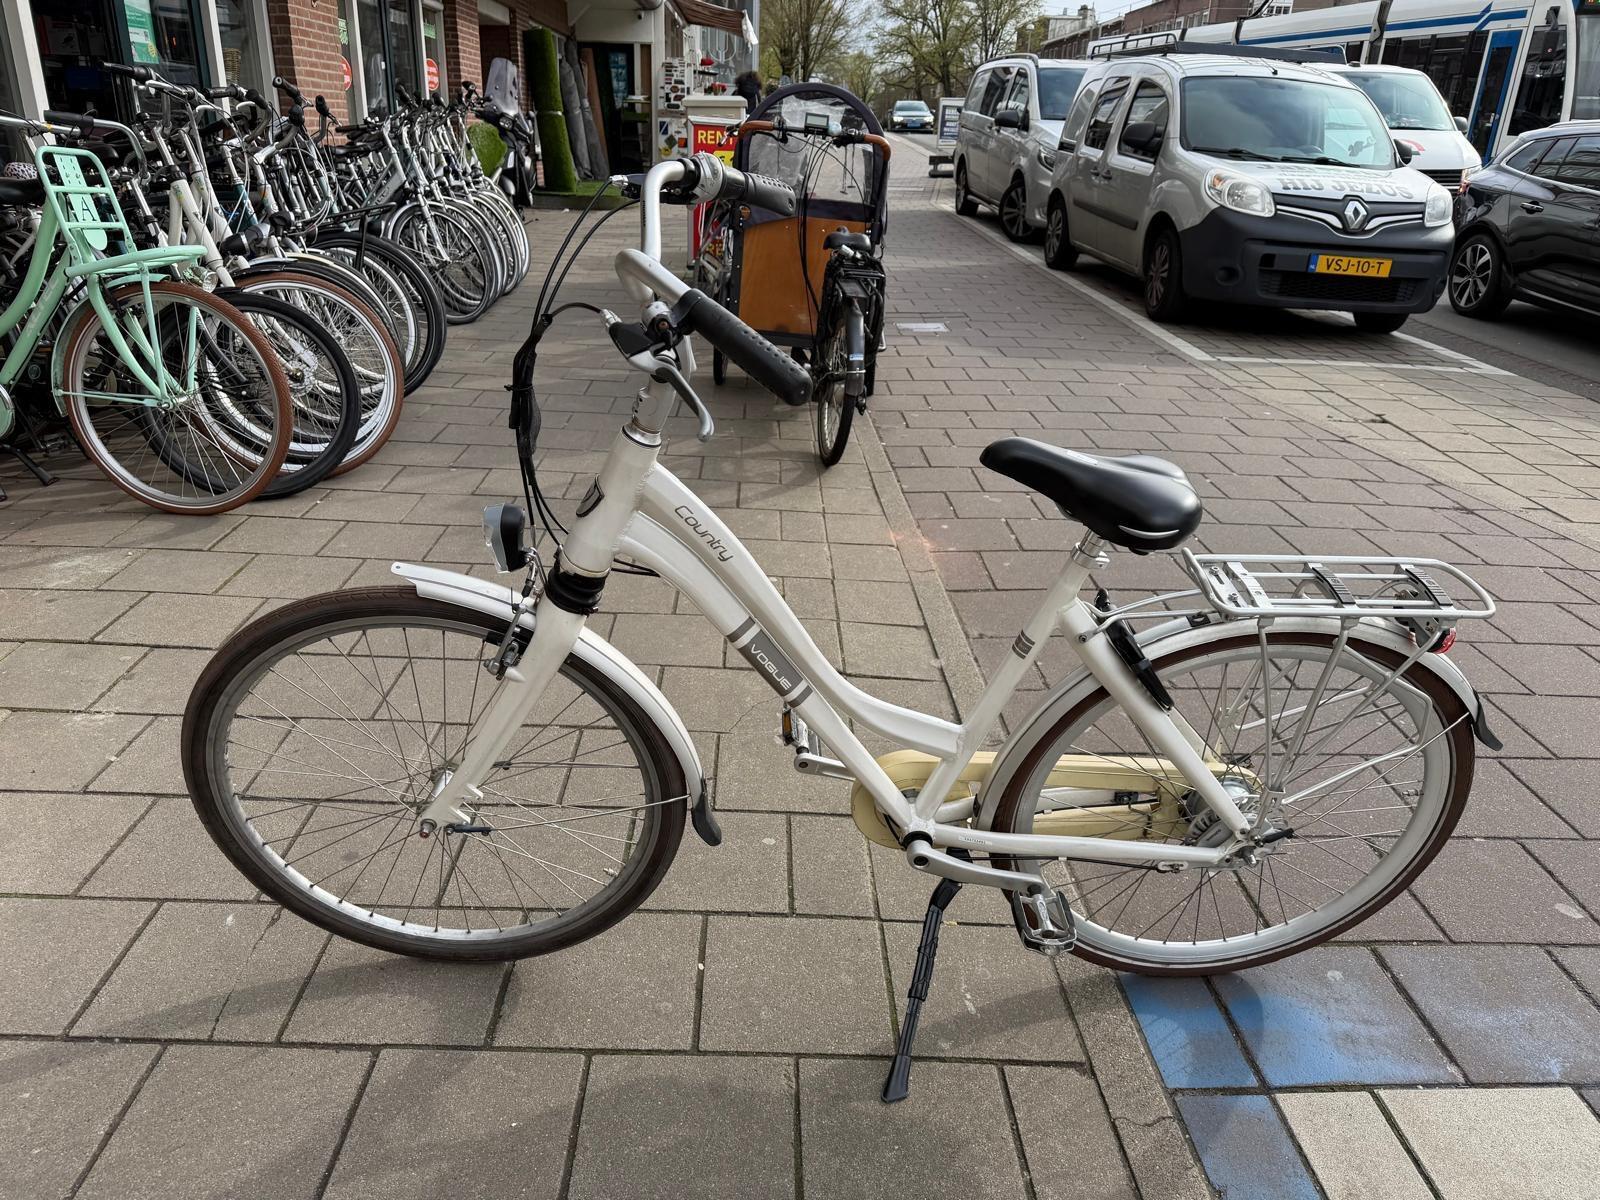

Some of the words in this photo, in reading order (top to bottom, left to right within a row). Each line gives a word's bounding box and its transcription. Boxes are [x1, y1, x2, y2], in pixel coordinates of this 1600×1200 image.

[1326, 257, 1385, 275] VSJ-10-T
[674, 505, 734, 562] Country
[751, 643, 792, 691] VOGUE
